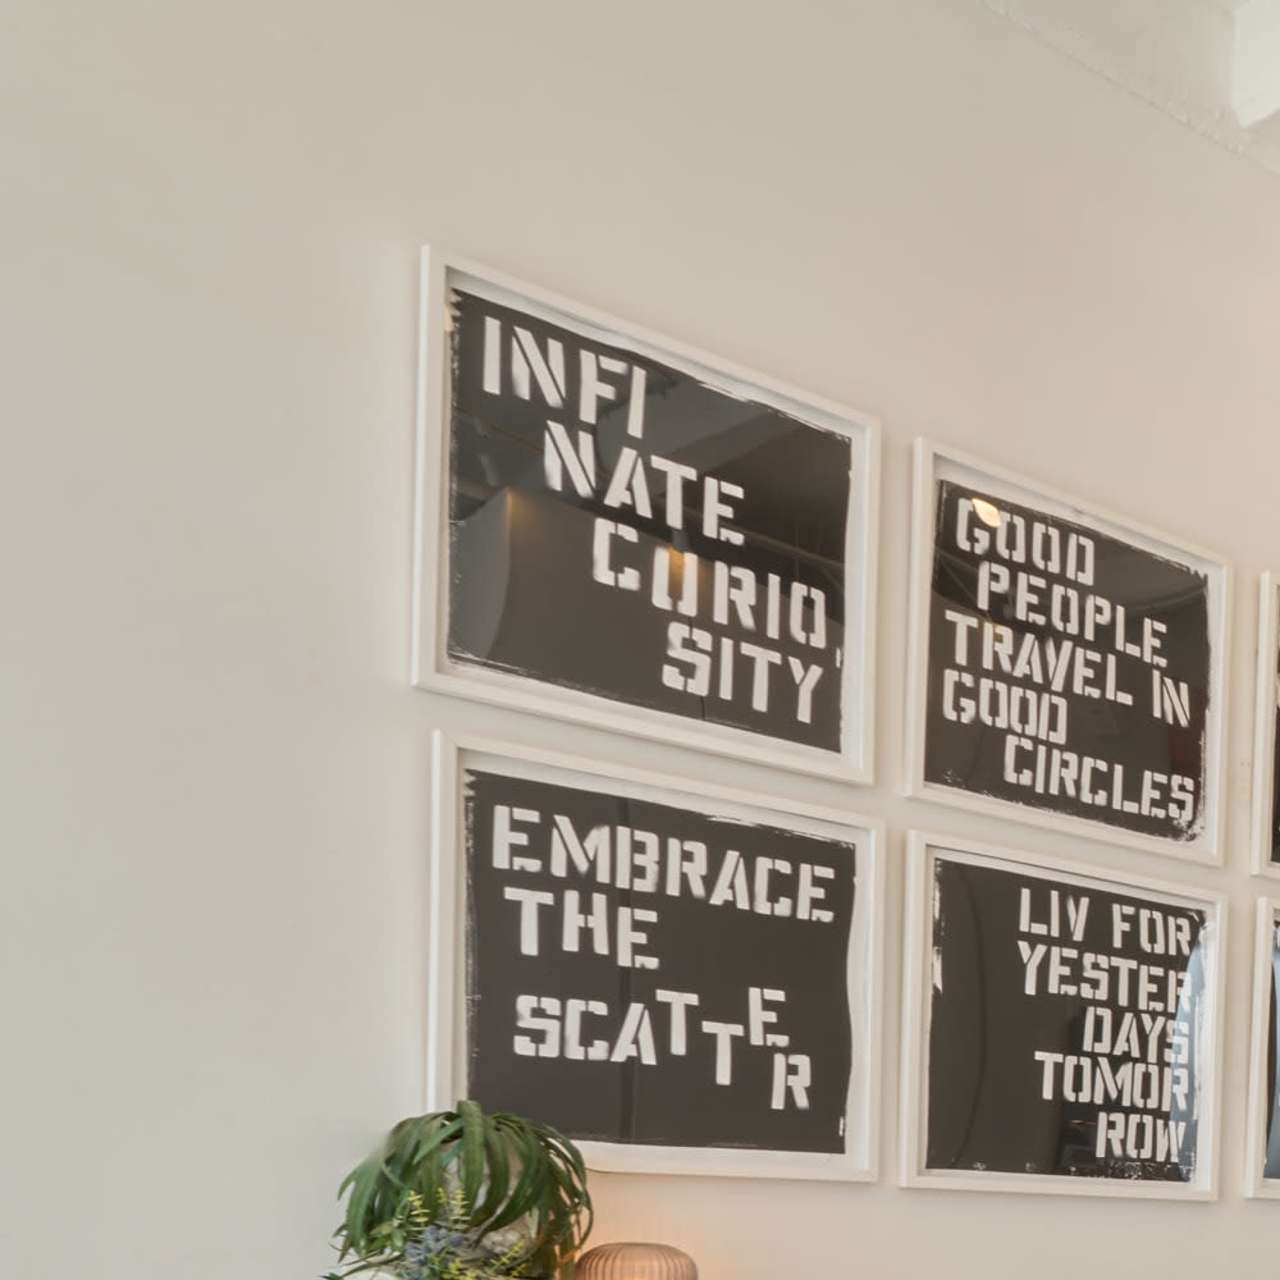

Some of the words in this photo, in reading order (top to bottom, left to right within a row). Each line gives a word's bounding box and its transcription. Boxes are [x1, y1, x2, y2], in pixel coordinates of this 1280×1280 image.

[483, 315, 646, 438] INFI
[543, 420, 744, 545] NATE
[593, 517, 827, 648] CURIO
[956, 497, 1095, 586] GOOD
[976, 560, 1168, 668] PEOPLE
[661, 621, 823, 723] SITY
[943, 668, 1068, 745] GOOD
[944, 609, 1133, 706] TRAVEL
[1152, 668, 1191, 728] IN
[1003, 733, 1194, 822] CIRCLES
[492, 804, 835, 923] EMBRACE
[504, 887, 659, 970] THE
[1019, 887, 1090, 942] LIV
[1112, 903, 1192, 956] FOR
[1017, 940, 1192, 1013] YESTER
[1083, 1006, 1190, 1065] DAYS
[1034, 1050, 1189, 1112] TOMOR
[1096, 1111, 1187, 1164] ROW
